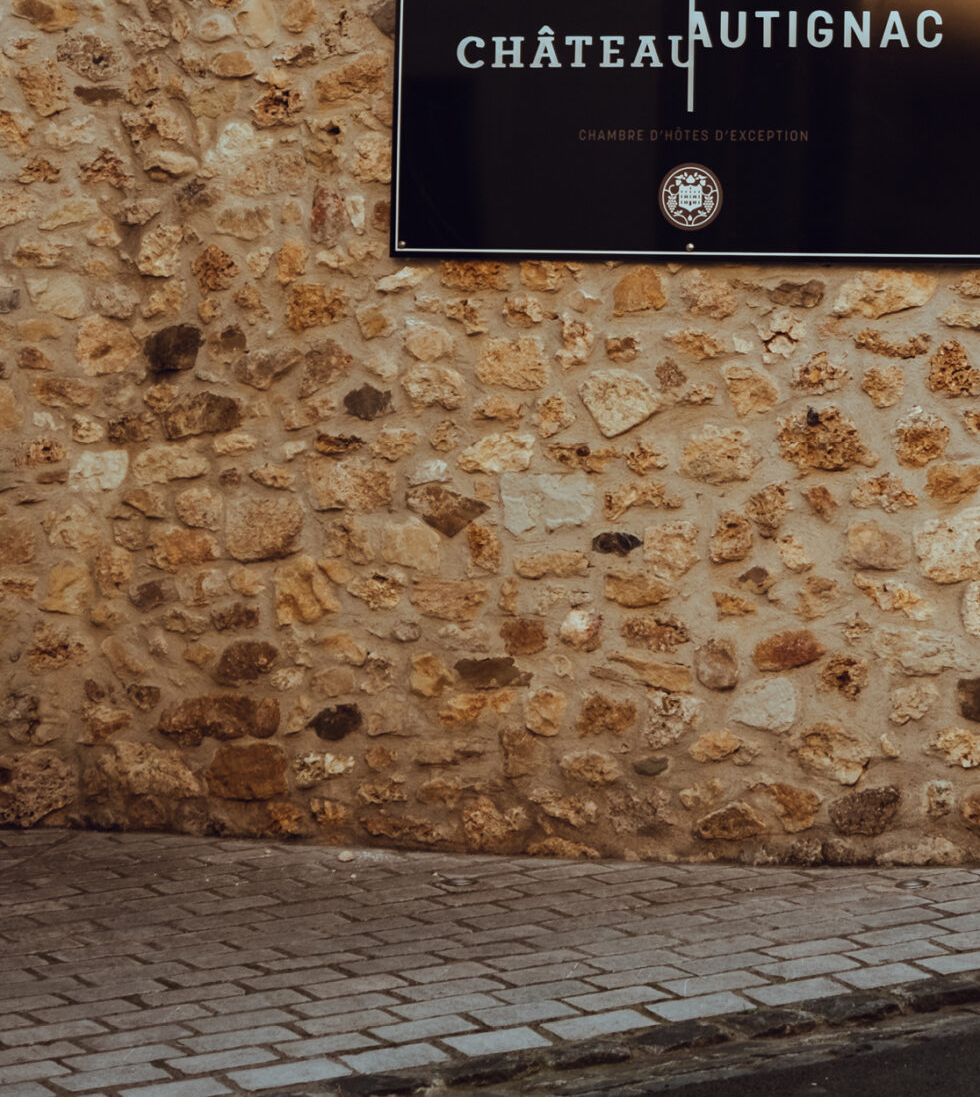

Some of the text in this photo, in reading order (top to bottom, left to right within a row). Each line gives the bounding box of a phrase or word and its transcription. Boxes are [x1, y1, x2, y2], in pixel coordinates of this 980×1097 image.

[456, 25, 696, 69] CHÂTEAU
[691, 9, 944, 49] AUTIGNAC
[578, 127, 809, 142] CHAMBRE D'HÔTES D'EXCEPTION
